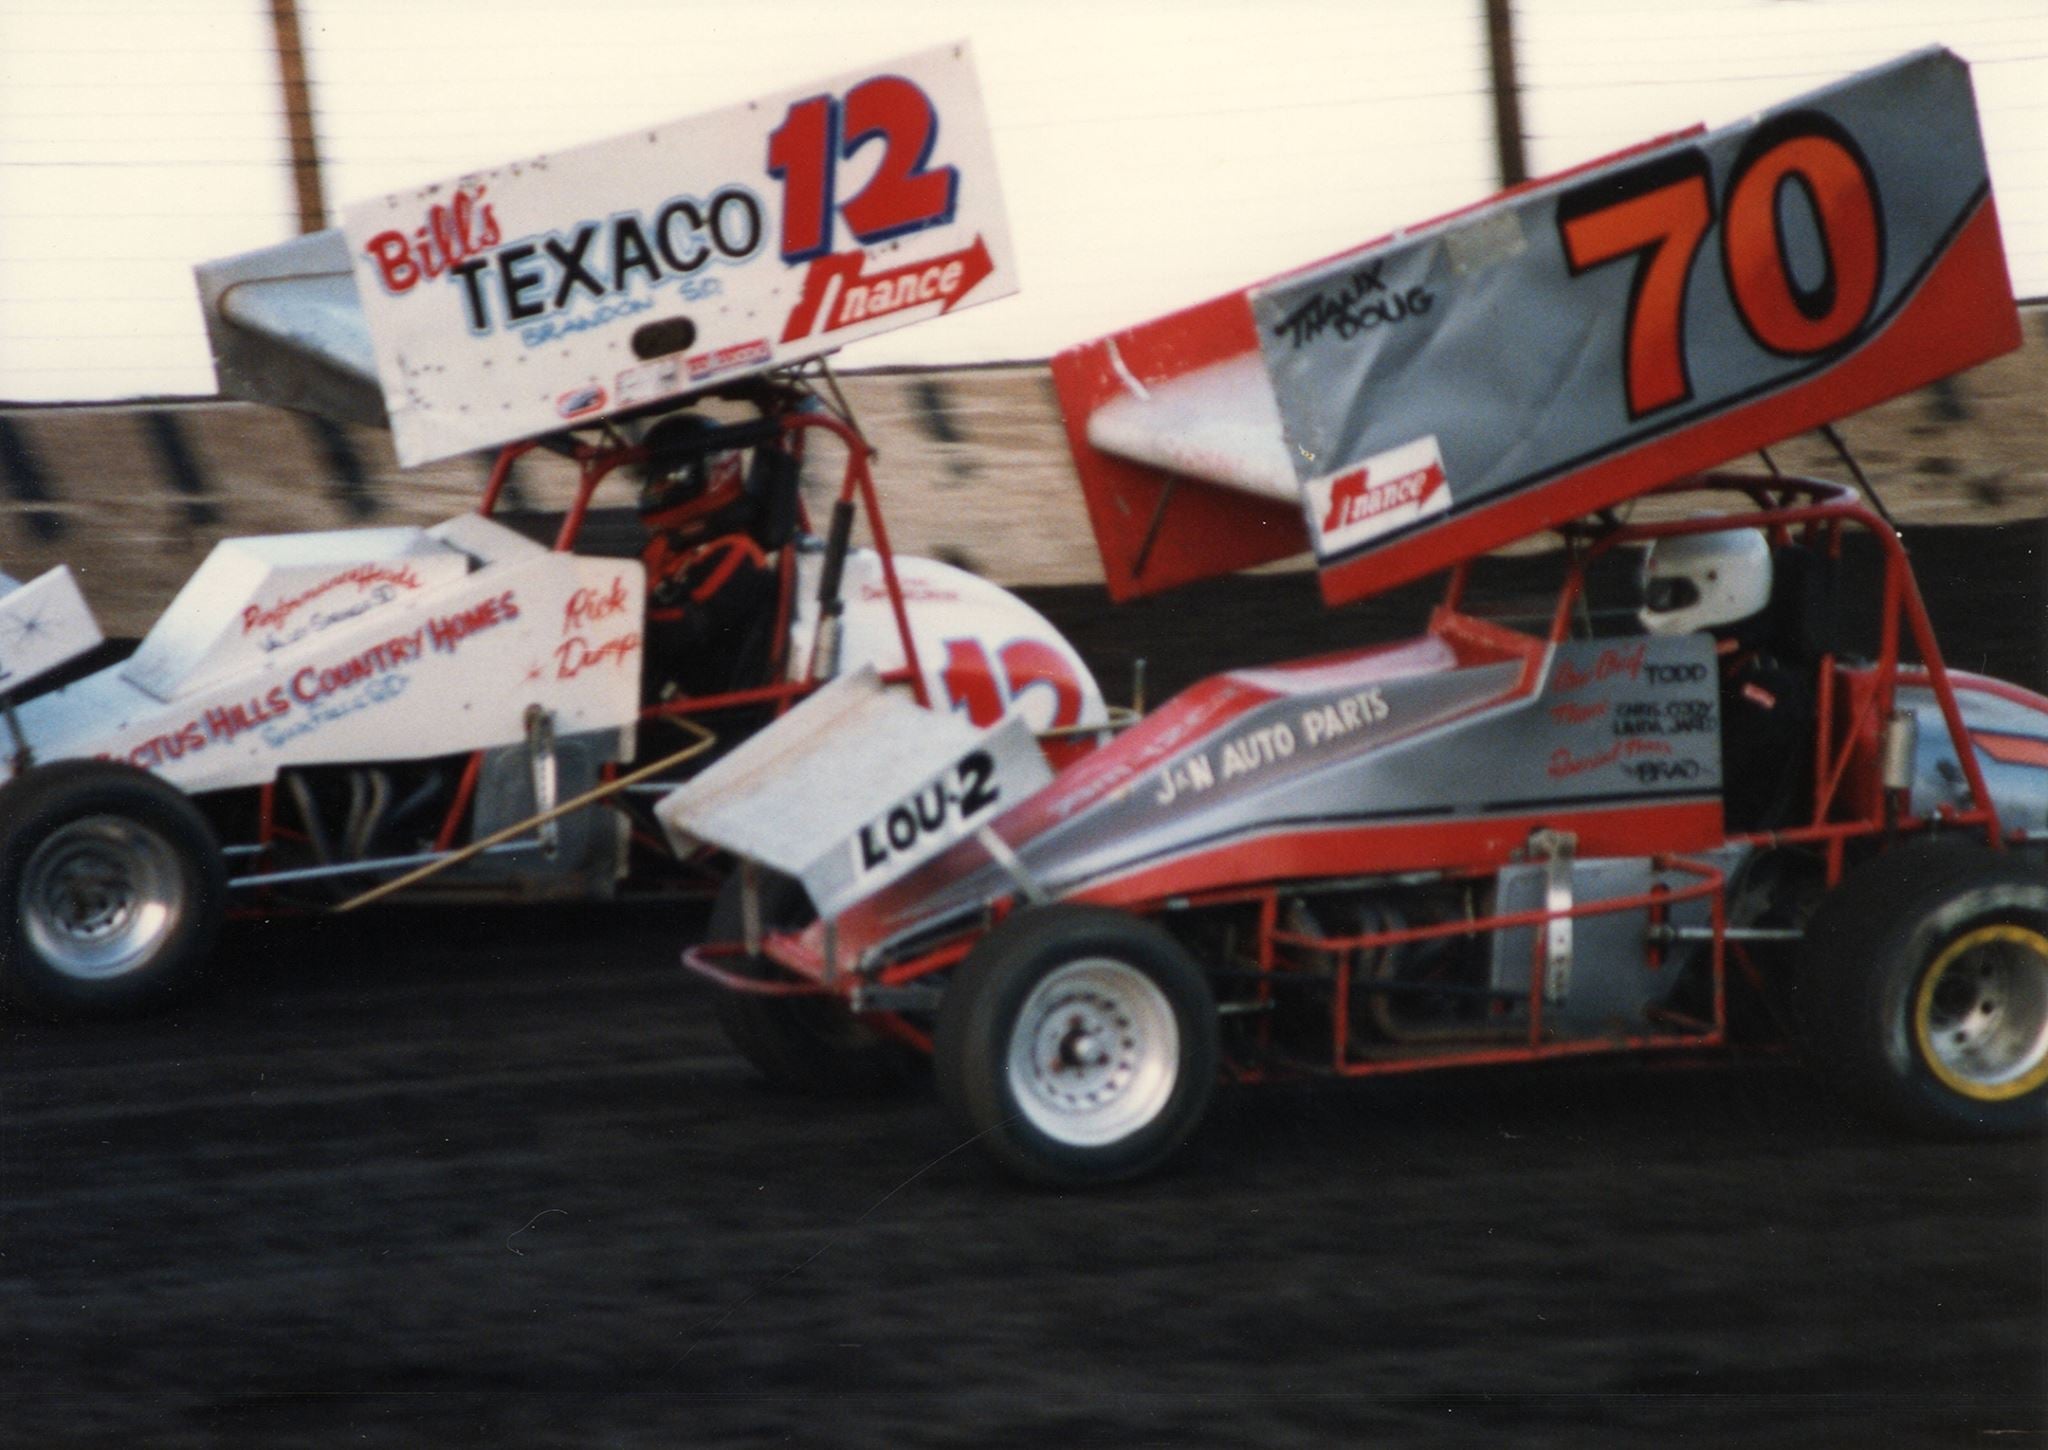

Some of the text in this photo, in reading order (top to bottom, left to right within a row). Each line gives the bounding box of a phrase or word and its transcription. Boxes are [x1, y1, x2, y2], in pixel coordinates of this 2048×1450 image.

[767, 74, 960, 264] 12
[366, 185, 502, 295] Bill's
[450, 189, 762, 332] TEXACO
[1557, 106, 1886, 421] 70
[1333, 285, 1435, 341] DOUG
[204, 683, 291, 742] HILLS
[291, 628, 426, 708] COUNTRY
[427, 590, 522, 656] HOMES
[941, 633, 1099, 772] 12
[1221, 723, 1296, 779] AUTO
[1302, 687, 1390, 746] PARTS
[1643, 661, 1710, 687] TODD
